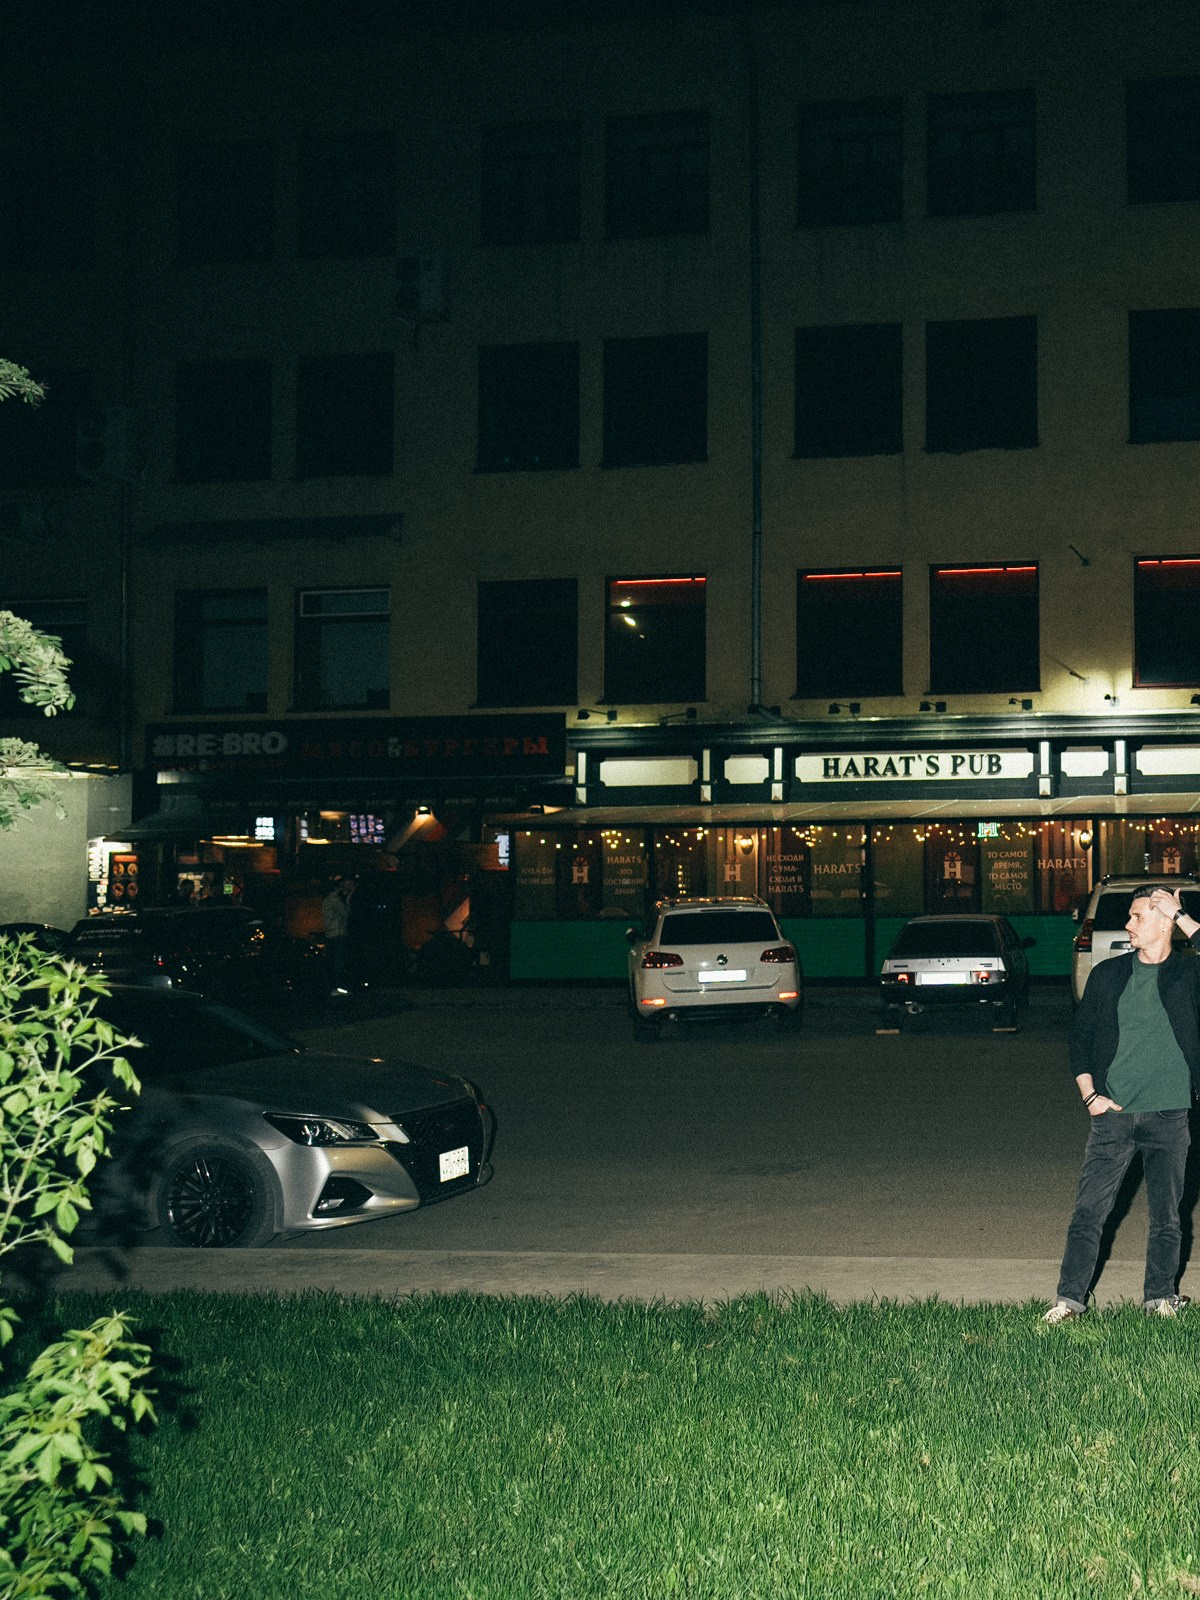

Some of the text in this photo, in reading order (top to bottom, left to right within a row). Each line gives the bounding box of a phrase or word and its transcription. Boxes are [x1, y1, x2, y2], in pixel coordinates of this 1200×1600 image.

[951, 753, 1002, 777] PUB
[999, 850, 1028, 858] САМОЕ
[1037, 858, 1087, 869] HARATS
[814, 863, 861, 874] HARATS
[999, 872, 1028, 880] САМОЕ
[768, 885, 804, 893] HARATS
